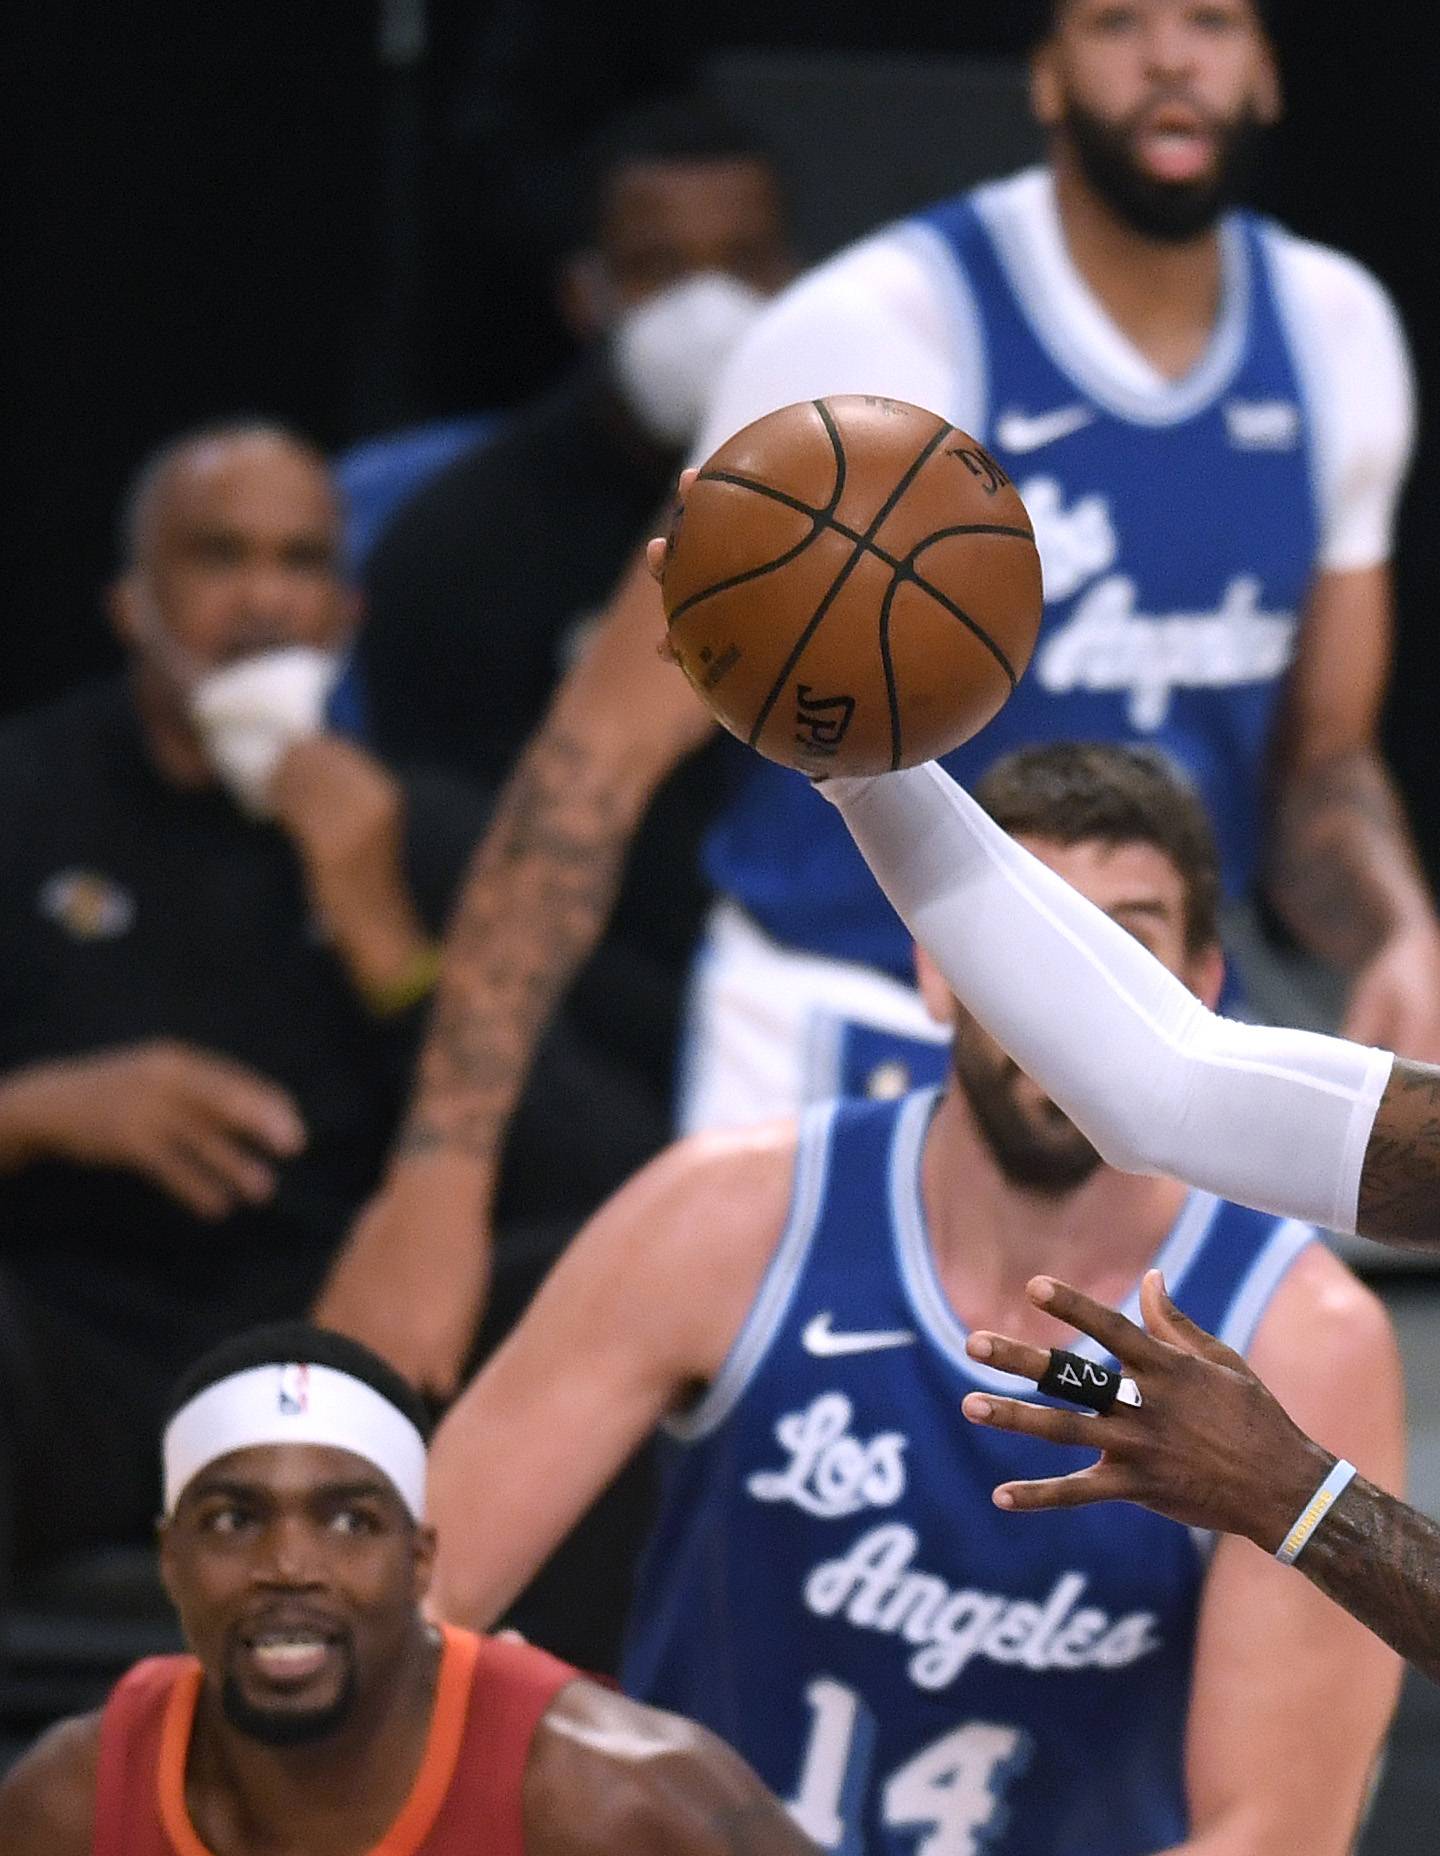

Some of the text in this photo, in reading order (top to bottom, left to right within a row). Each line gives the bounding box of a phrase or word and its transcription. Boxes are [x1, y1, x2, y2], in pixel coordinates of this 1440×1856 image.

[1057, 1362, 1108, 1387] 24
[748, 1394, 908, 1515] Los
[806, 1524, 1160, 1688] Angeles
